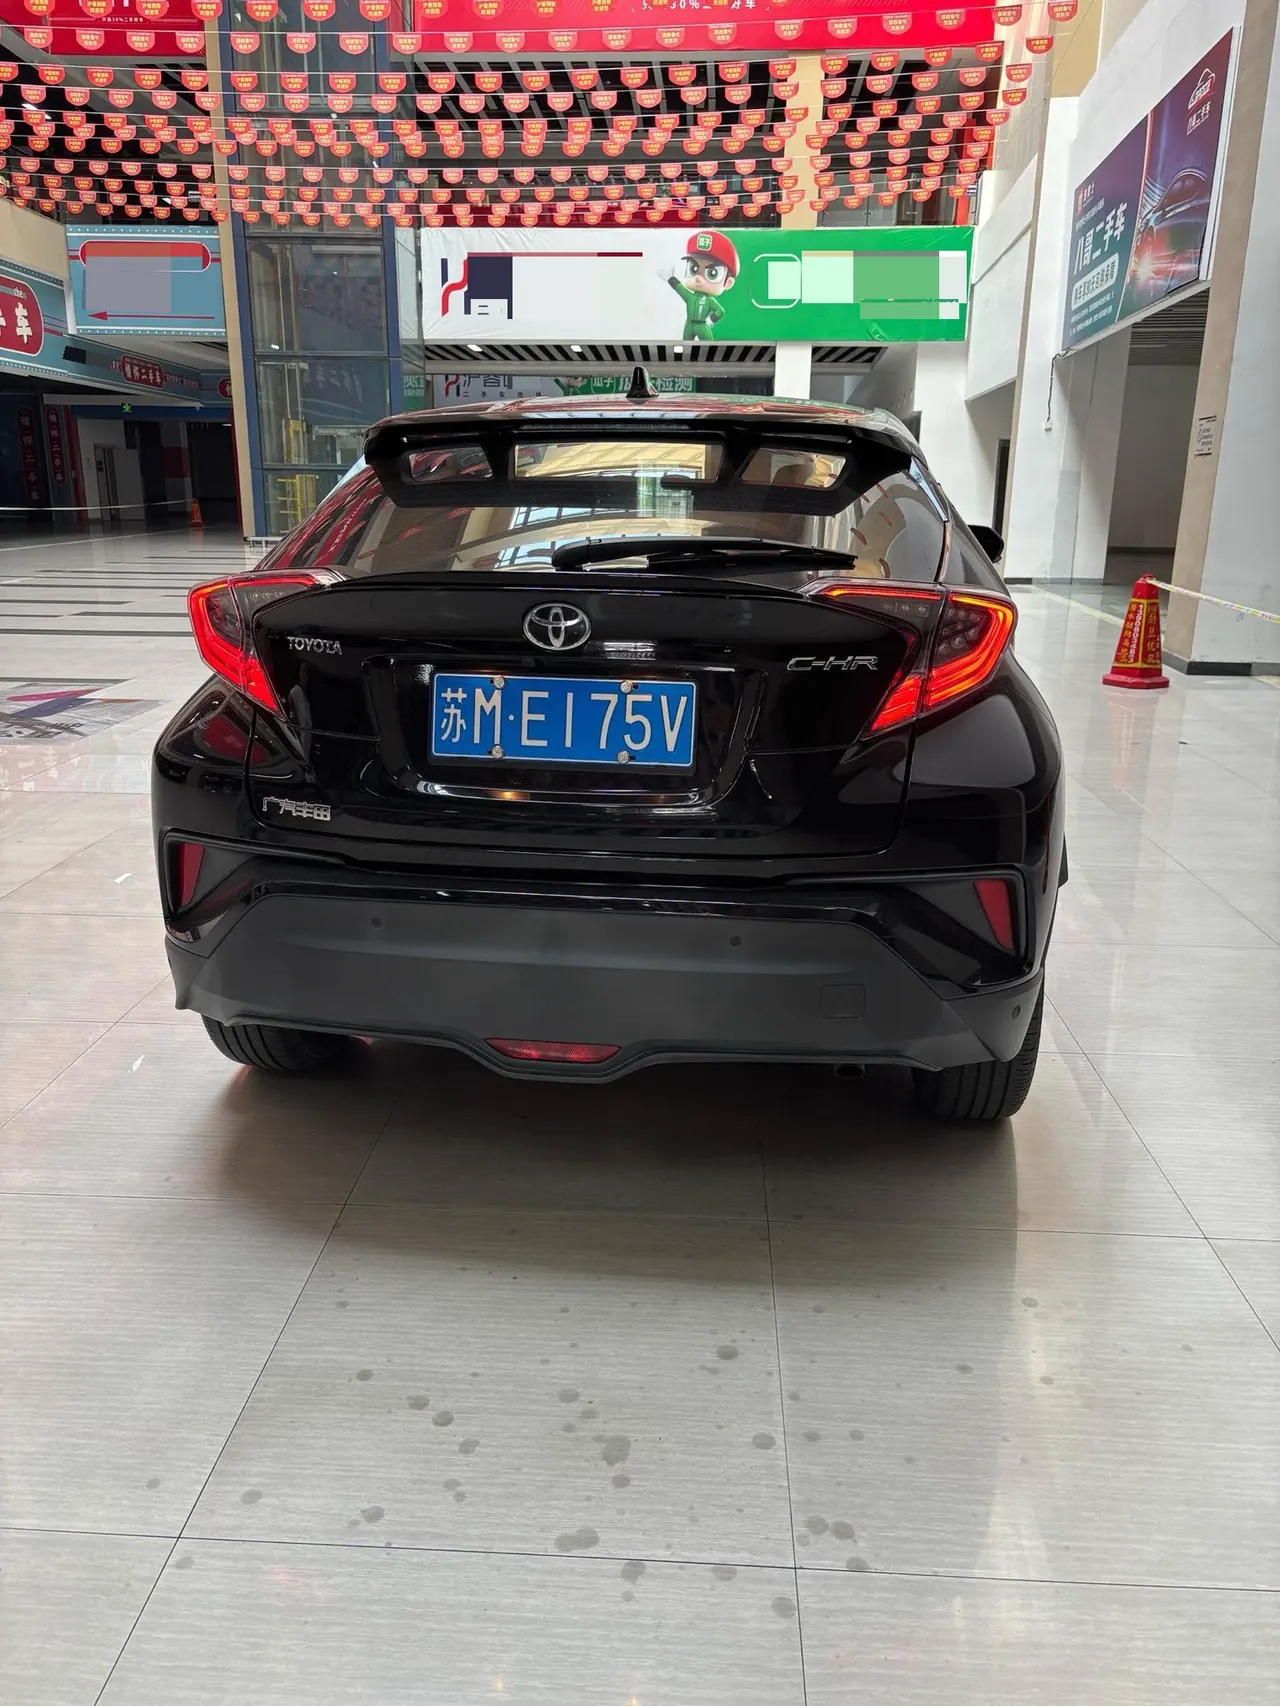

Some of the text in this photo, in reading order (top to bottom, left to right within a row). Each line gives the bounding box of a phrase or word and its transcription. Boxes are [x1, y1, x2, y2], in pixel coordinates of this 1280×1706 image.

[1073, 200, 1128, 276] 八哥二手车
[618, 376, 693, 392] 瓜检测
[288, 635, 343, 656] TOYOTA
[786, 655, 879, 672] C-HR
[262, 796, 332, 821] 广汽丰田
